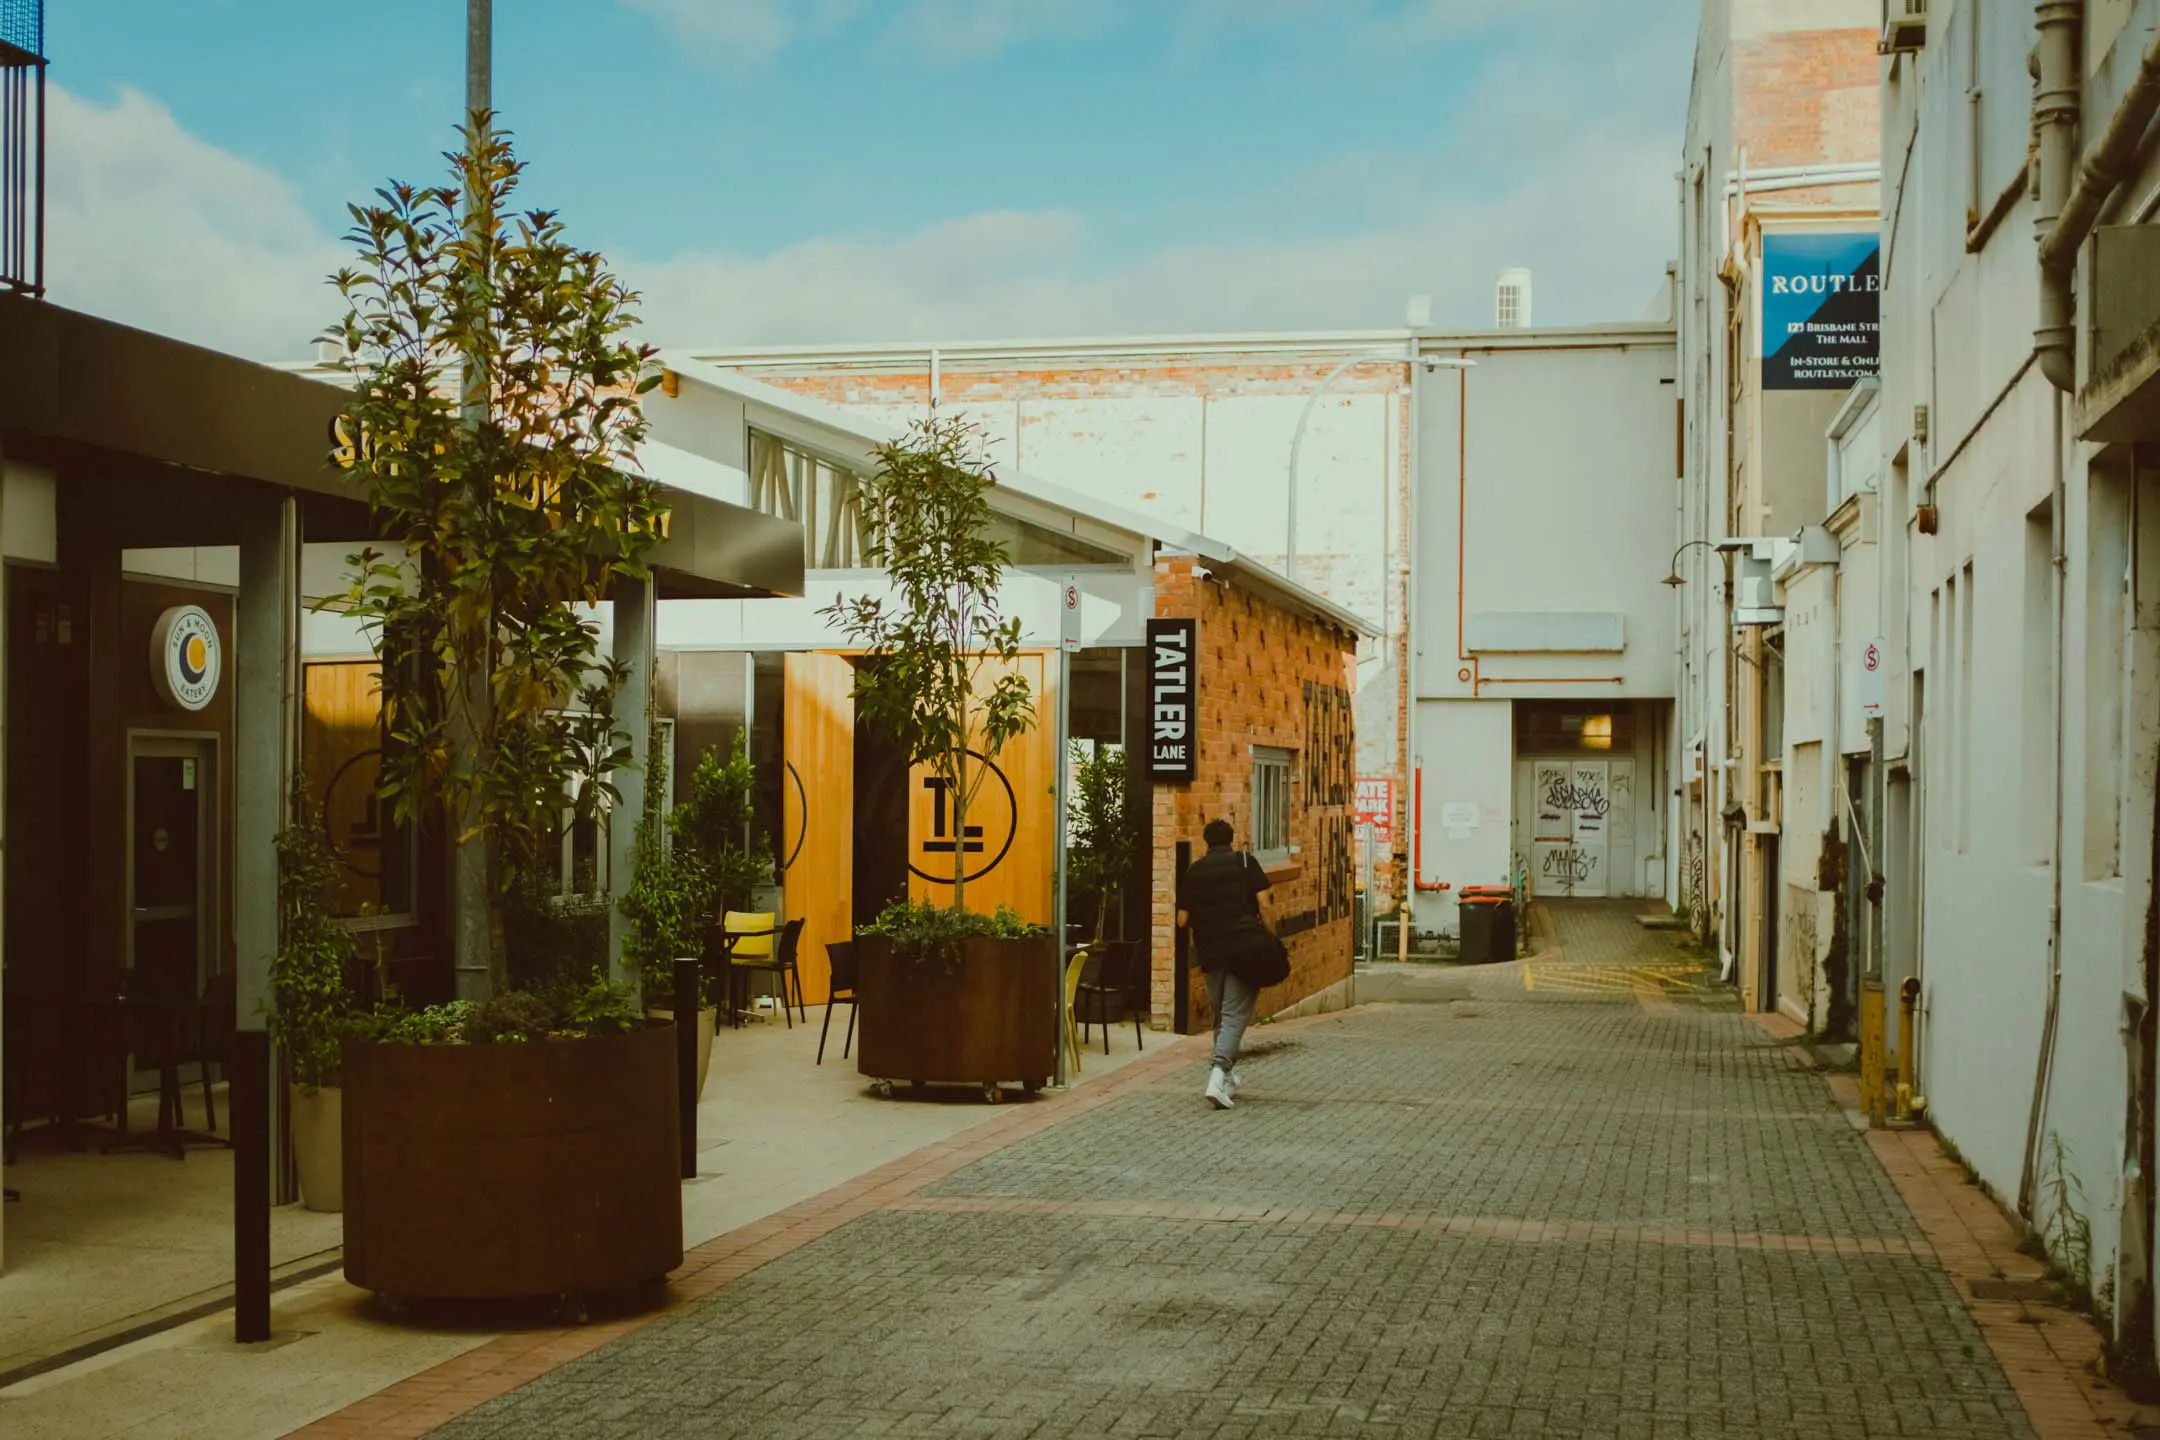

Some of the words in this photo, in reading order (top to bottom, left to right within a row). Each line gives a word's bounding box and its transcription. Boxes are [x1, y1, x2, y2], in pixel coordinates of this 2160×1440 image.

[1771, 274, 1879, 294] ROUTLE
[1807, 322, 1857, 333] BRISBANE
[1816, 334, 1837, 345] THE
[1839, 334, 1868, 344] MALL
[1790, 356, 1839, 367] IN-STORE
[1841, 356, 1851, 366] &
[173, 626, 185, 647] SUN
[194, 620, 213, 648] MOON
[181, 685, 206, 699] EATERY
[1154, 629, 1187, 741] TATLER
[1153, 744, 1187, 760] LANE
[1355, 782, 1389, 798] ATE
